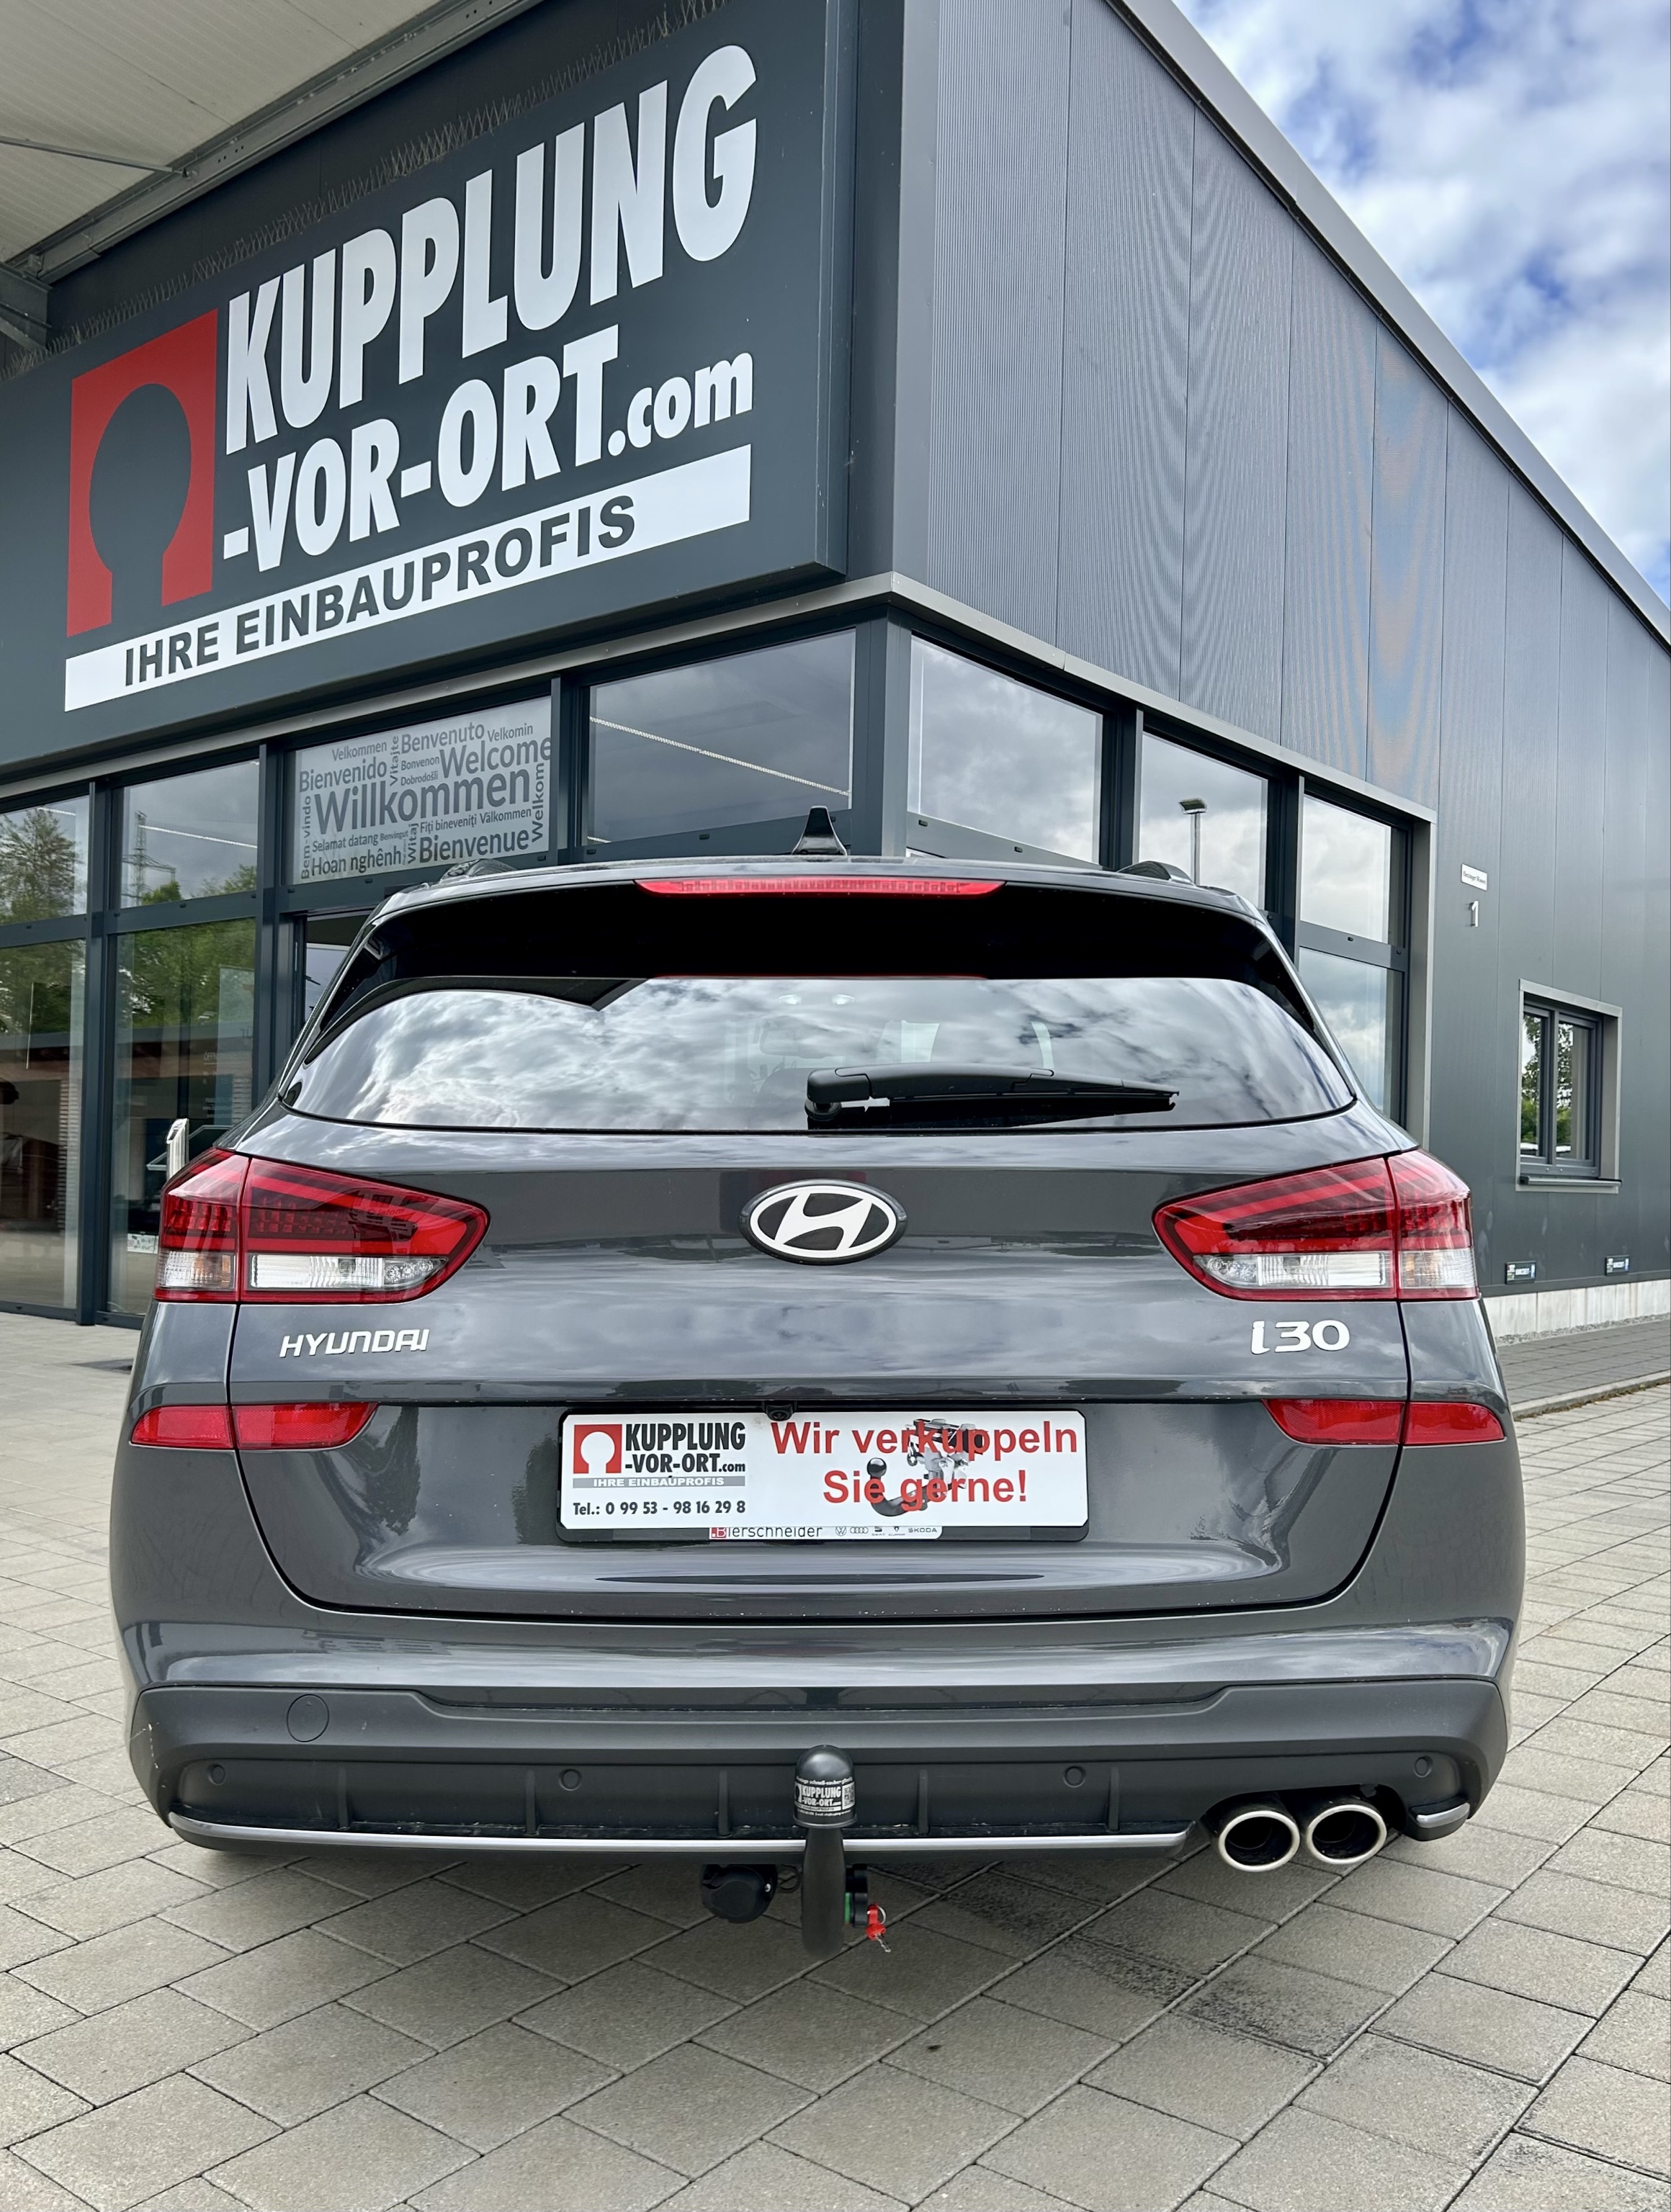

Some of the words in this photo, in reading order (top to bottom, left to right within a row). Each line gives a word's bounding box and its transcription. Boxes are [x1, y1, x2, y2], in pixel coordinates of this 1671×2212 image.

[226, 44, 757, 454] KUPPLUNG
[223, 325, 753, 572] -VOR-ORT.com
[125, 624, 219, 686] IHRE
[236, 494, 636, 652] EINBAUPROFIS
[401, 722, 485, 754] Benvenuto
[488, 723, 533, 742] Velkomin
[332, 741, 387, 761] Velkommen
[390, 736, 400, 786] Vitajte
[400, 756, 440, 770] Bonvenon
[439, 737, 552, 778] Welcome
[300, 757, 387, 793] Bienvenido
[400, 770, 439, 786] Dobrodošli
[314, 768, 530, 835] Willkommen
[480, 809, 532, 824] Välkommen
[532, 763, 545, 842] Welkom
[301, 796, 311, 879] Bem-vindo
[313, 837, 346, 853] Selamat
[349, 834, 379, 846] datang
[408, 823, 419, 864] Witaj
[420, 830, 529, 863] Bienvenue
[312, 857, 346, 876] Hoan
[351, 845, 401, 873] nghênh
[1471, 900, 1479, 927] 1
[279, 1329, 430, 1358] HYUNDAI
[1251, 1320, 1350, 1354] i30
[625, 1422, 745, 1451] KUPPLUNG
[771, 1421, 840, 1454] Wir
[852, 1421, 1078, 1461] verkuppeln
[625, 1453, 745, 1473] -VOR-ORT.com
[593, 1478, 624, 1487] IHRE
[629, 1477, 725, 1486] EINBAUPROFIS
[823, 1470, 885, 1503] Sie
[900, 1470, 1026, 1511] gerne!
[573, 1502, 600, 1514] Tel.:
[606, 1502, 614, 1514] 0
[620, 1502, 638, 1514] 99
[643, 1501, 658, 1514] 53
[673, 1501, 691, 1514] 98
[696, 1501, 710, 1514] 16
[714, 1501, 731, 1514] 29
[736, 1501, 745, 1513] 8
[802, 1785, 841, 1799] KUPPLUNG
